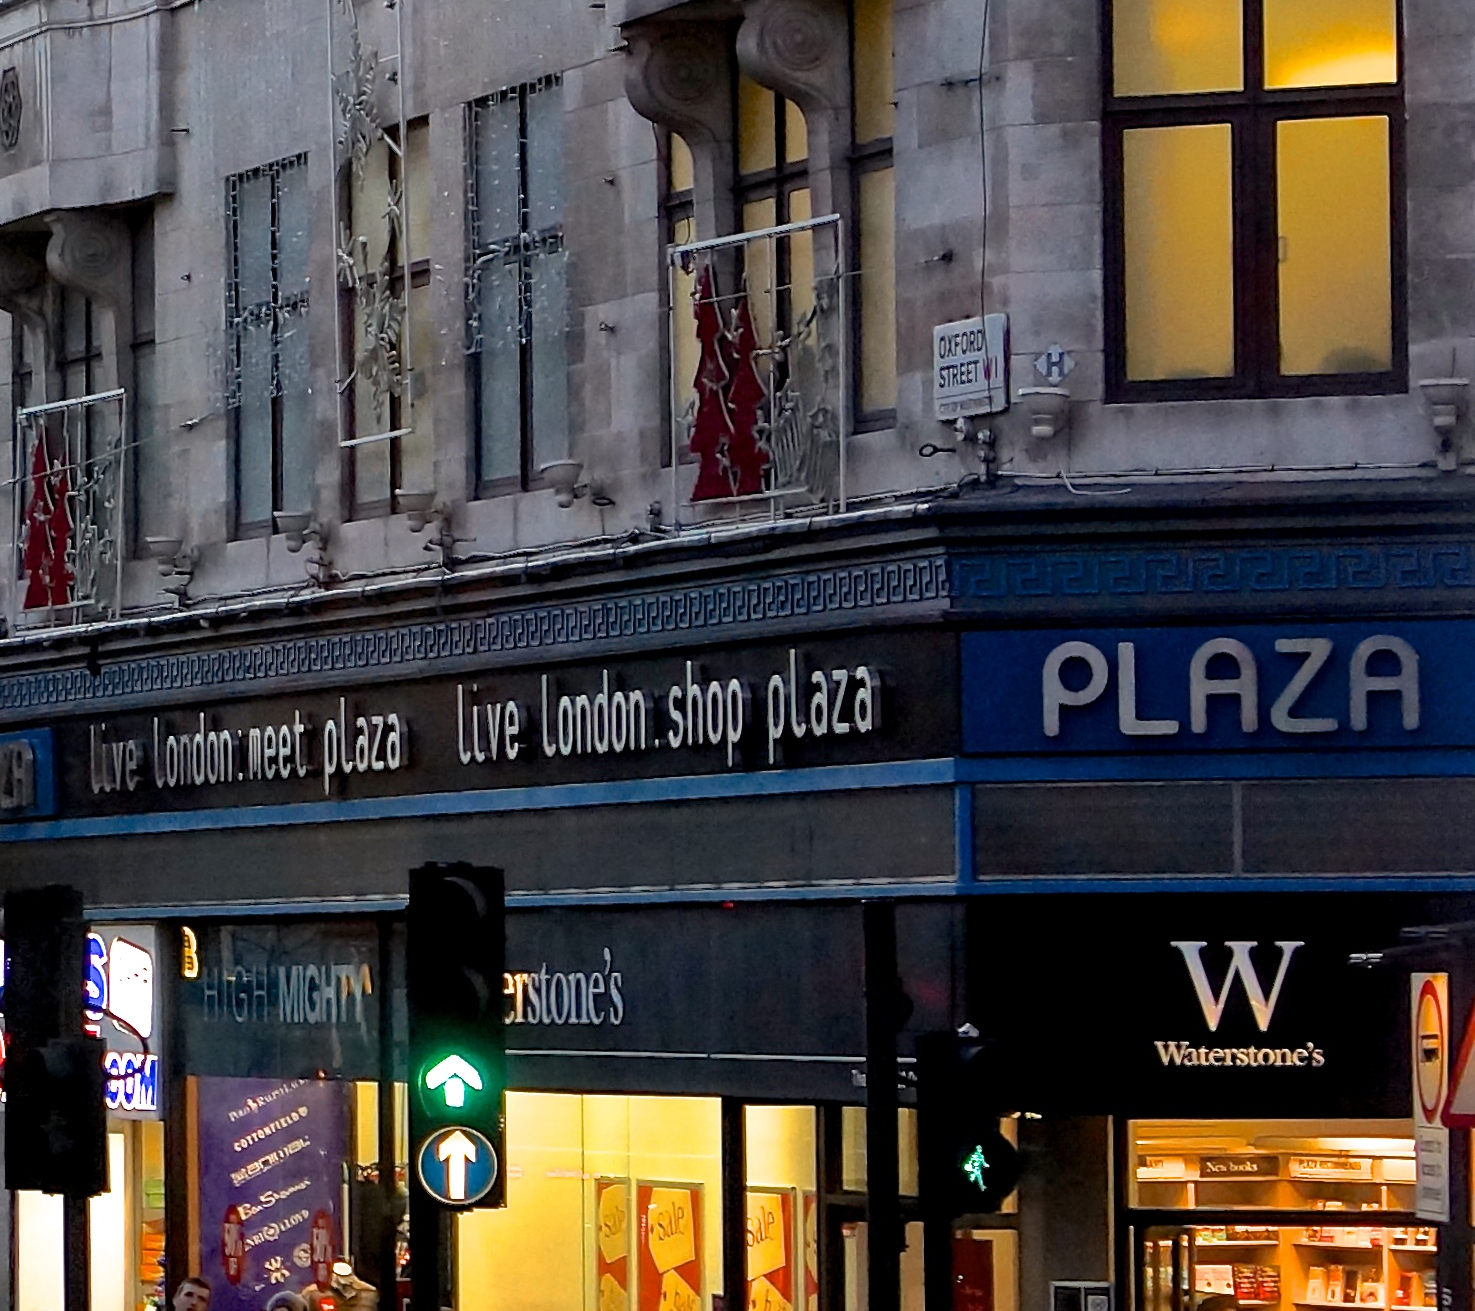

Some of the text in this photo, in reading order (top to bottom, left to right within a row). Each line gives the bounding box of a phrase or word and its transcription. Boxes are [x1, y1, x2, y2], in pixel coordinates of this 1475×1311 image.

[938, 329, 983, 359] OXFORD
[1047, 352, 1064, 377] H
[938, 360, 980, 388] STREET
[457, 683, 520, 766] live
[767, 648, 874, 766] plaza
[1042, 634, 1420, 738] PLAZA
[89, 724, 137, 794] live
[322, 695, 401, 794] plaza
[203, 963, 372, 1025] HIGH MIGHTY
[502, 946, 624, 1027] erstone's
[1169, 941, 1306, 1032] W
[1153, 1041, 1325, 1067] Waterstone's
[233, 1111, 301, 1152] COTTONFIELD
[1227, 1161, 1259, 1173] books
[657, 1201, 686, 1241] sale
[746, 1205, 776, 1248] sale
